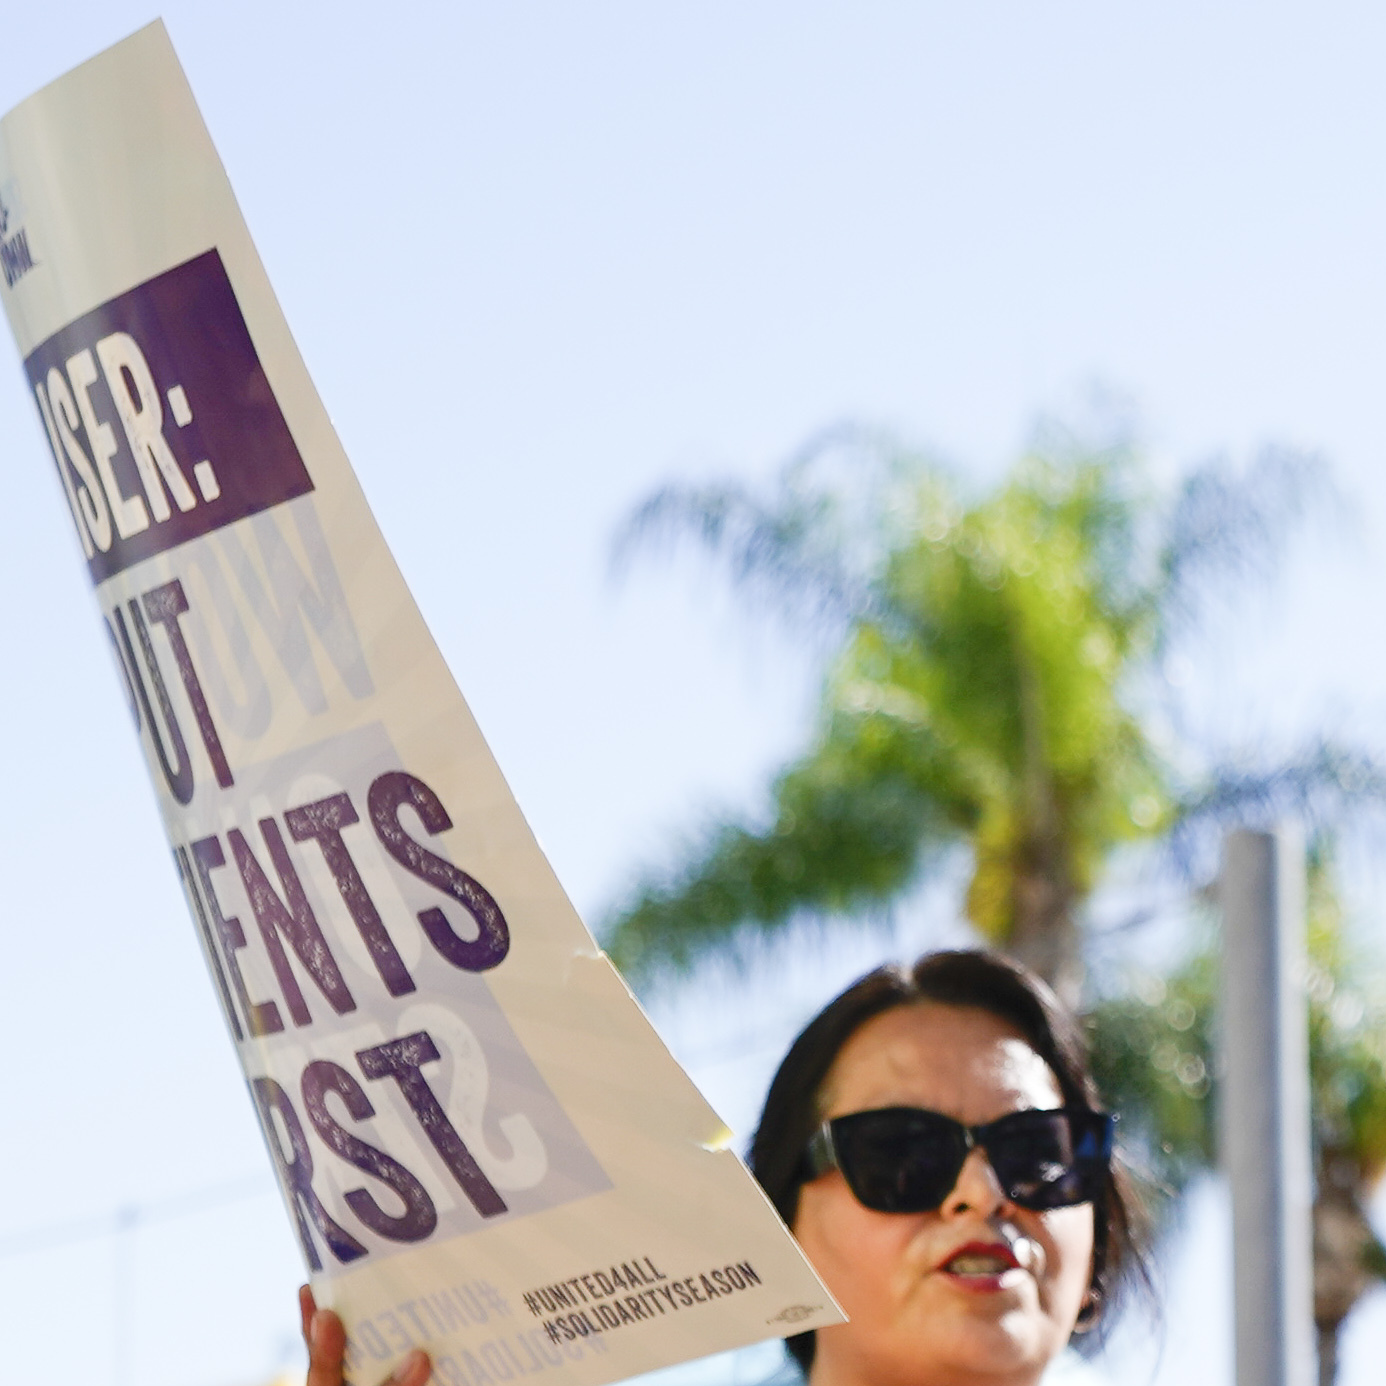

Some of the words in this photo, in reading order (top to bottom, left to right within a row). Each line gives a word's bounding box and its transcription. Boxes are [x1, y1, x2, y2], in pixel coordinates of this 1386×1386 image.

[101, 577, 235, 806] UT
[523, 1256, 667, 1317] #UNITED4ALL
[543, 1260, 763, 1345] #SOLIDARITYSEASON
